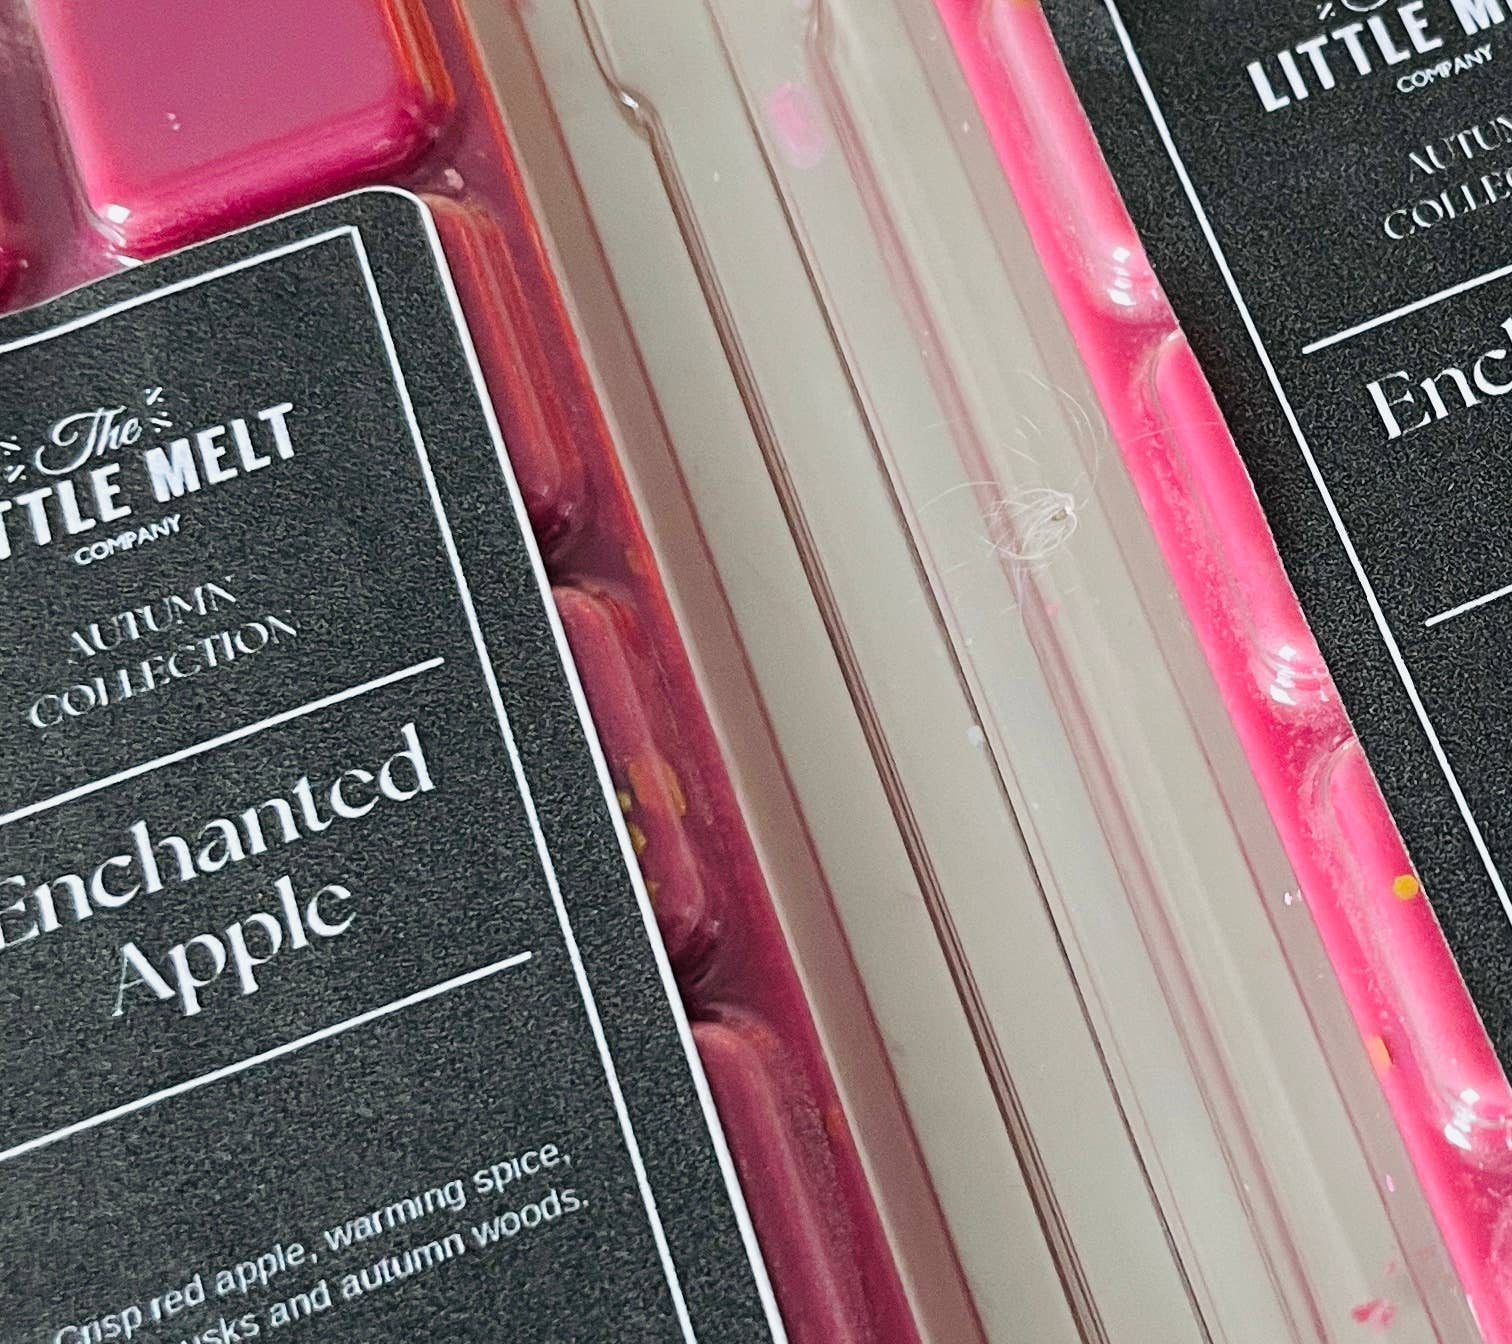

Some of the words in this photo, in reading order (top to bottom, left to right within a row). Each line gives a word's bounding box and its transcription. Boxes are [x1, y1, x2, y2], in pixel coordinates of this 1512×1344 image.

[1247, 0, 1443, 113] LITTLE
[1397, 44, 1493, 93] COMPANY
[35, 407, 141, 475] The
[145, 402, 295, 503] MELT
[74, 513, 181, 566] COMPANY
[30, 610, 297, 727] COLLECTION
[68, 576, 237, 663] AUTUMN
[112, 875, 357, 1017] Apple
[150, 1273, 205, 1322] red
[215, 1239, 319, 1297] apple,
[324, 1179, 466, 1251] warming
[475, 1141, 571, 1196] spice,
[270, 1279, 332, 1328] and
[342, 1231, 466, 1299] autumn
[472, 1186, 590, 1248] woods.
